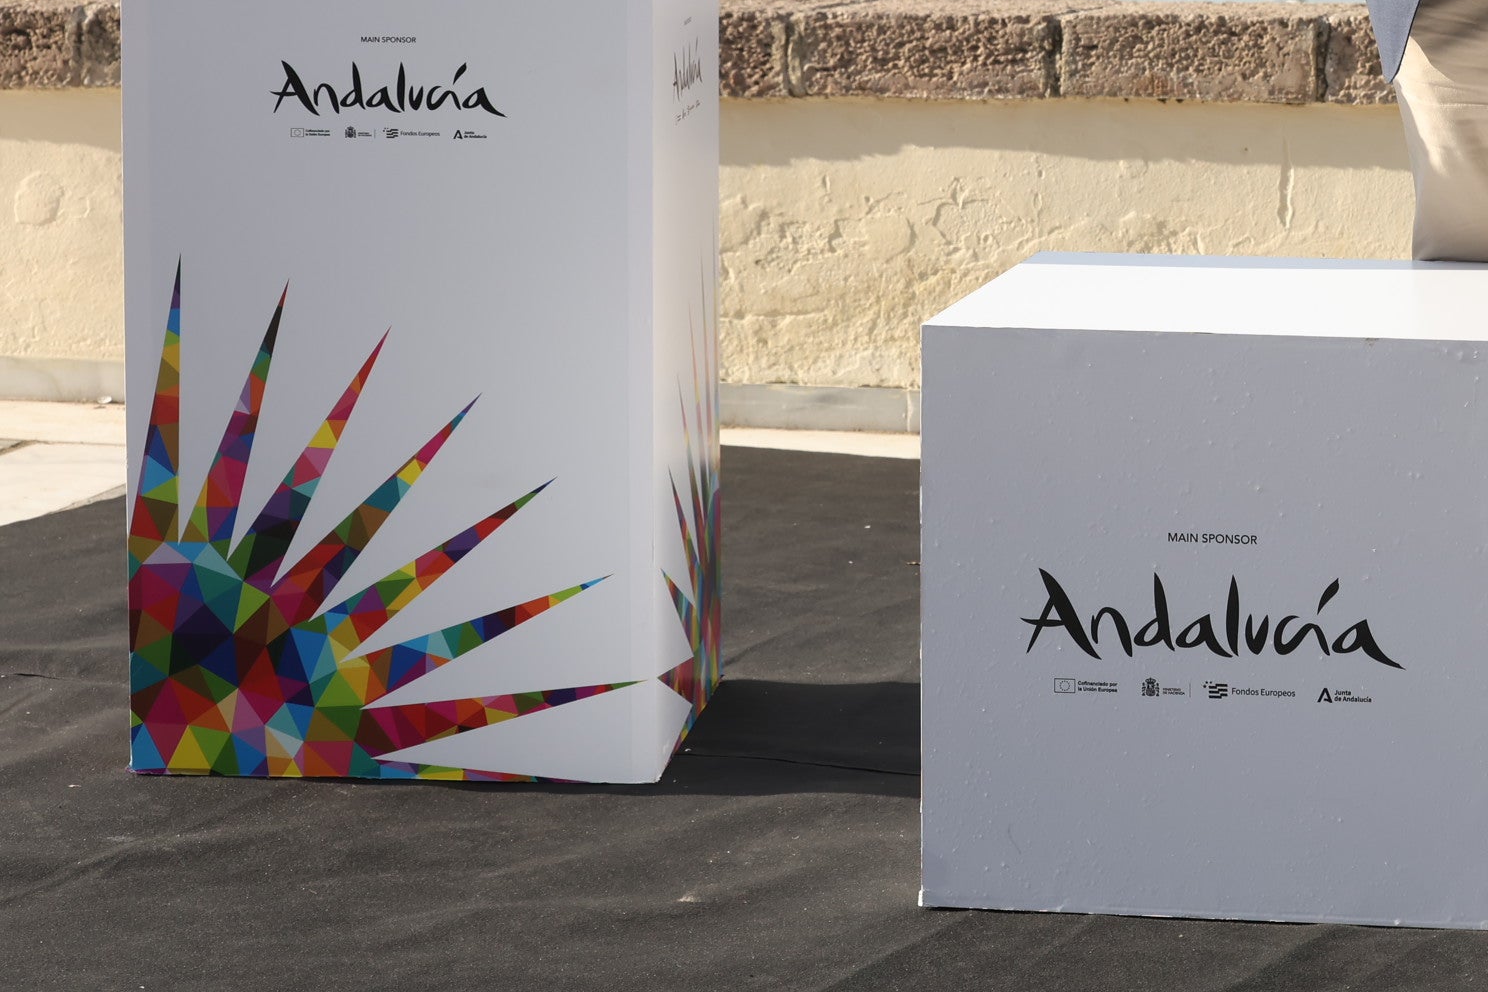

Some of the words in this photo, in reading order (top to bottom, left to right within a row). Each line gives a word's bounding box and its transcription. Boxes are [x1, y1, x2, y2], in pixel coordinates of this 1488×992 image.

[381, 36, 417, 44] SPONSOR
[269, 60, 507, 118] Andalucía
[1167, 532, 1199, 544] MAIN
[1201, 532, 1258, 545] SPONSOR
[1020, 567, 1406, 670] Andalucía
[1231, 688, 1259, 696] Fondos
[1260, 688, 1296, 698] Europeos
